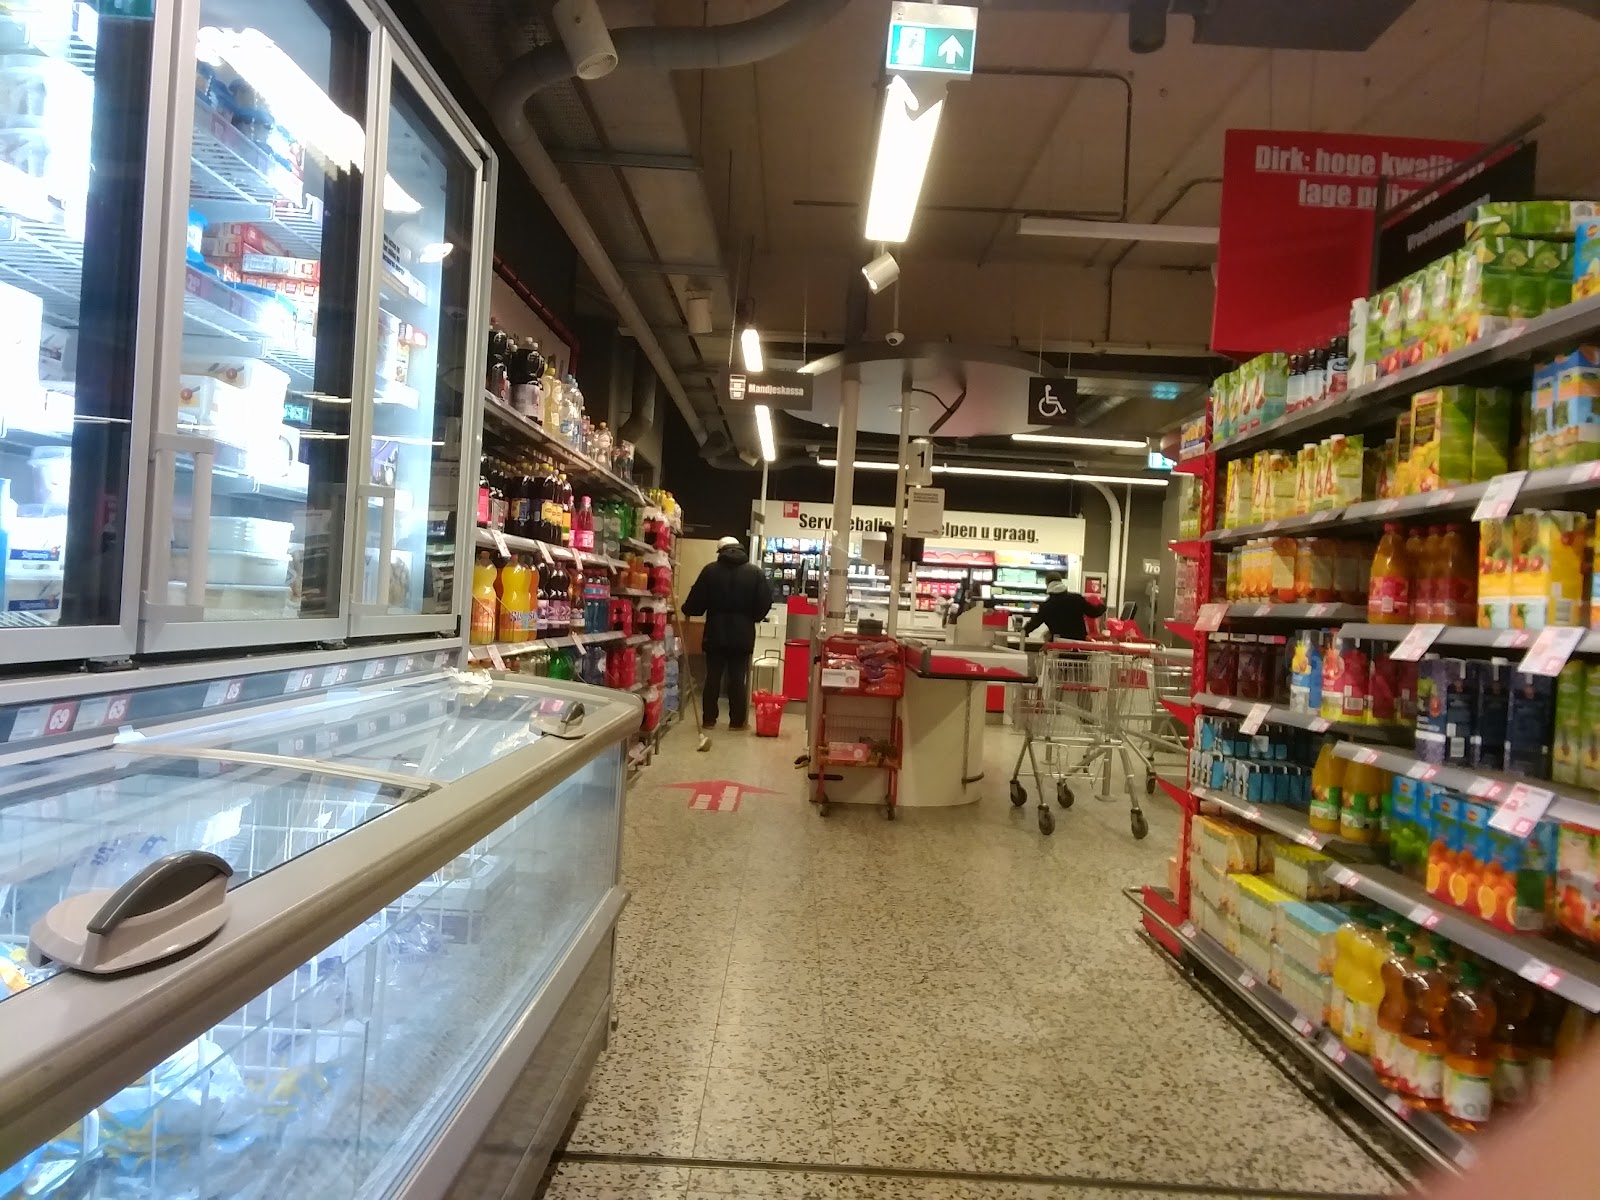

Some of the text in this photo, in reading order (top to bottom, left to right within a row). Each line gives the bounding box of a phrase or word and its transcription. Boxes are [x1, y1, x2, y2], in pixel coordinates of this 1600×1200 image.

[1255, 145, 1311, 172] Dirk:
[1316, 149, 1376, 176] hoge
[1299, 179, 1352, 206] lage
[917, 451, 925, 468] 1
[981, 526, 990, 539] u
[993, 526, 1039, 543] graag.
[49, 708, 71, 730] 69
[108, 699, 127, 720] 65
